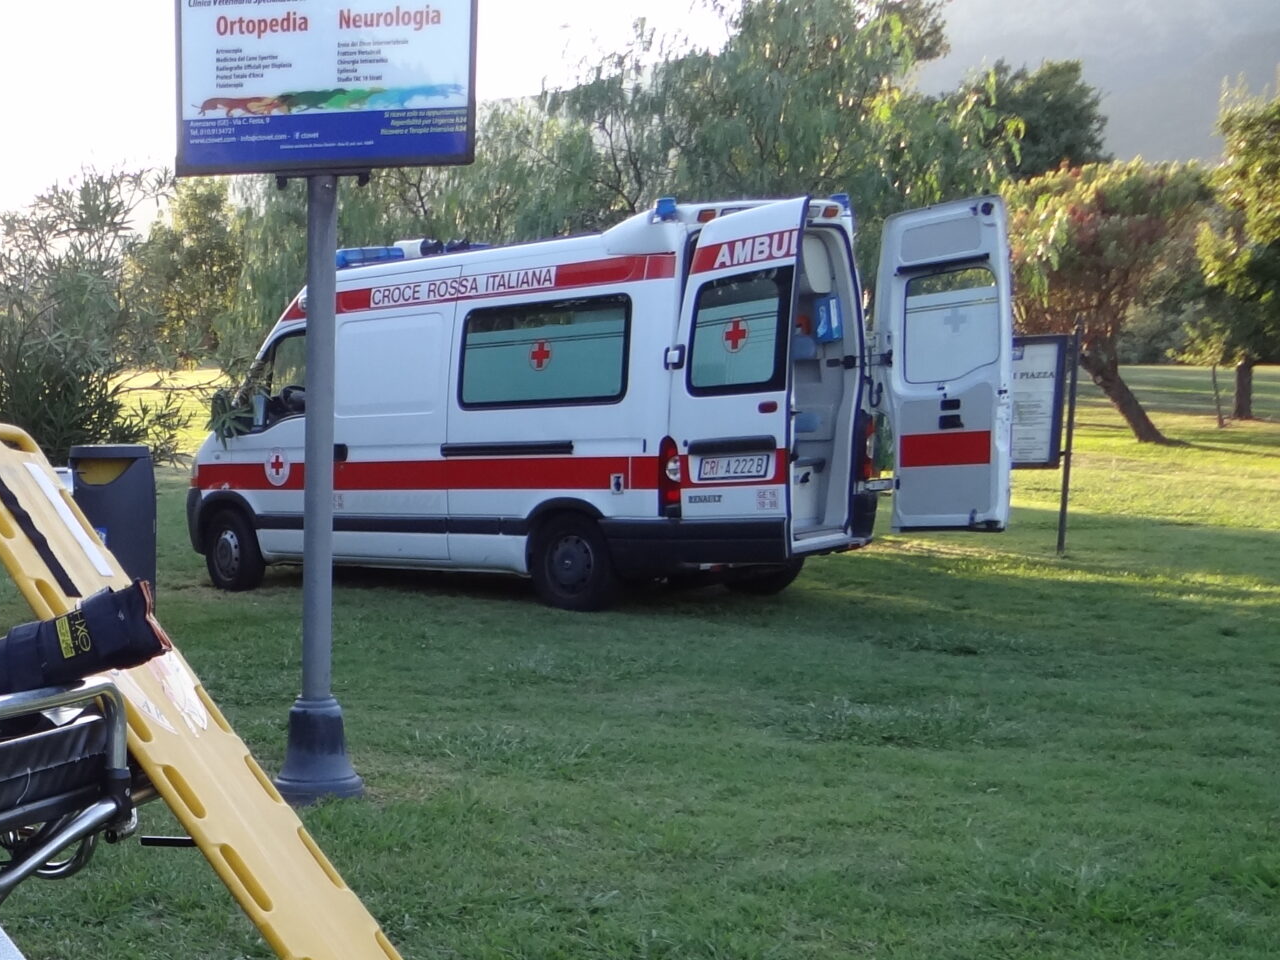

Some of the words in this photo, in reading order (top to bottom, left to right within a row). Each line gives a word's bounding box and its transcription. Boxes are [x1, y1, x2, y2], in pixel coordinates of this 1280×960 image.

[216, 11, 308, 39] Ortopedia
[339, 5, 441, 31] Neurologia
[372, 285, 421, 306] CROCE
[427, 277, 478, 299] ROSSA
[485, 269, 552, 292] ITALIANA
[689, 495, 722, 504] RENAULT
